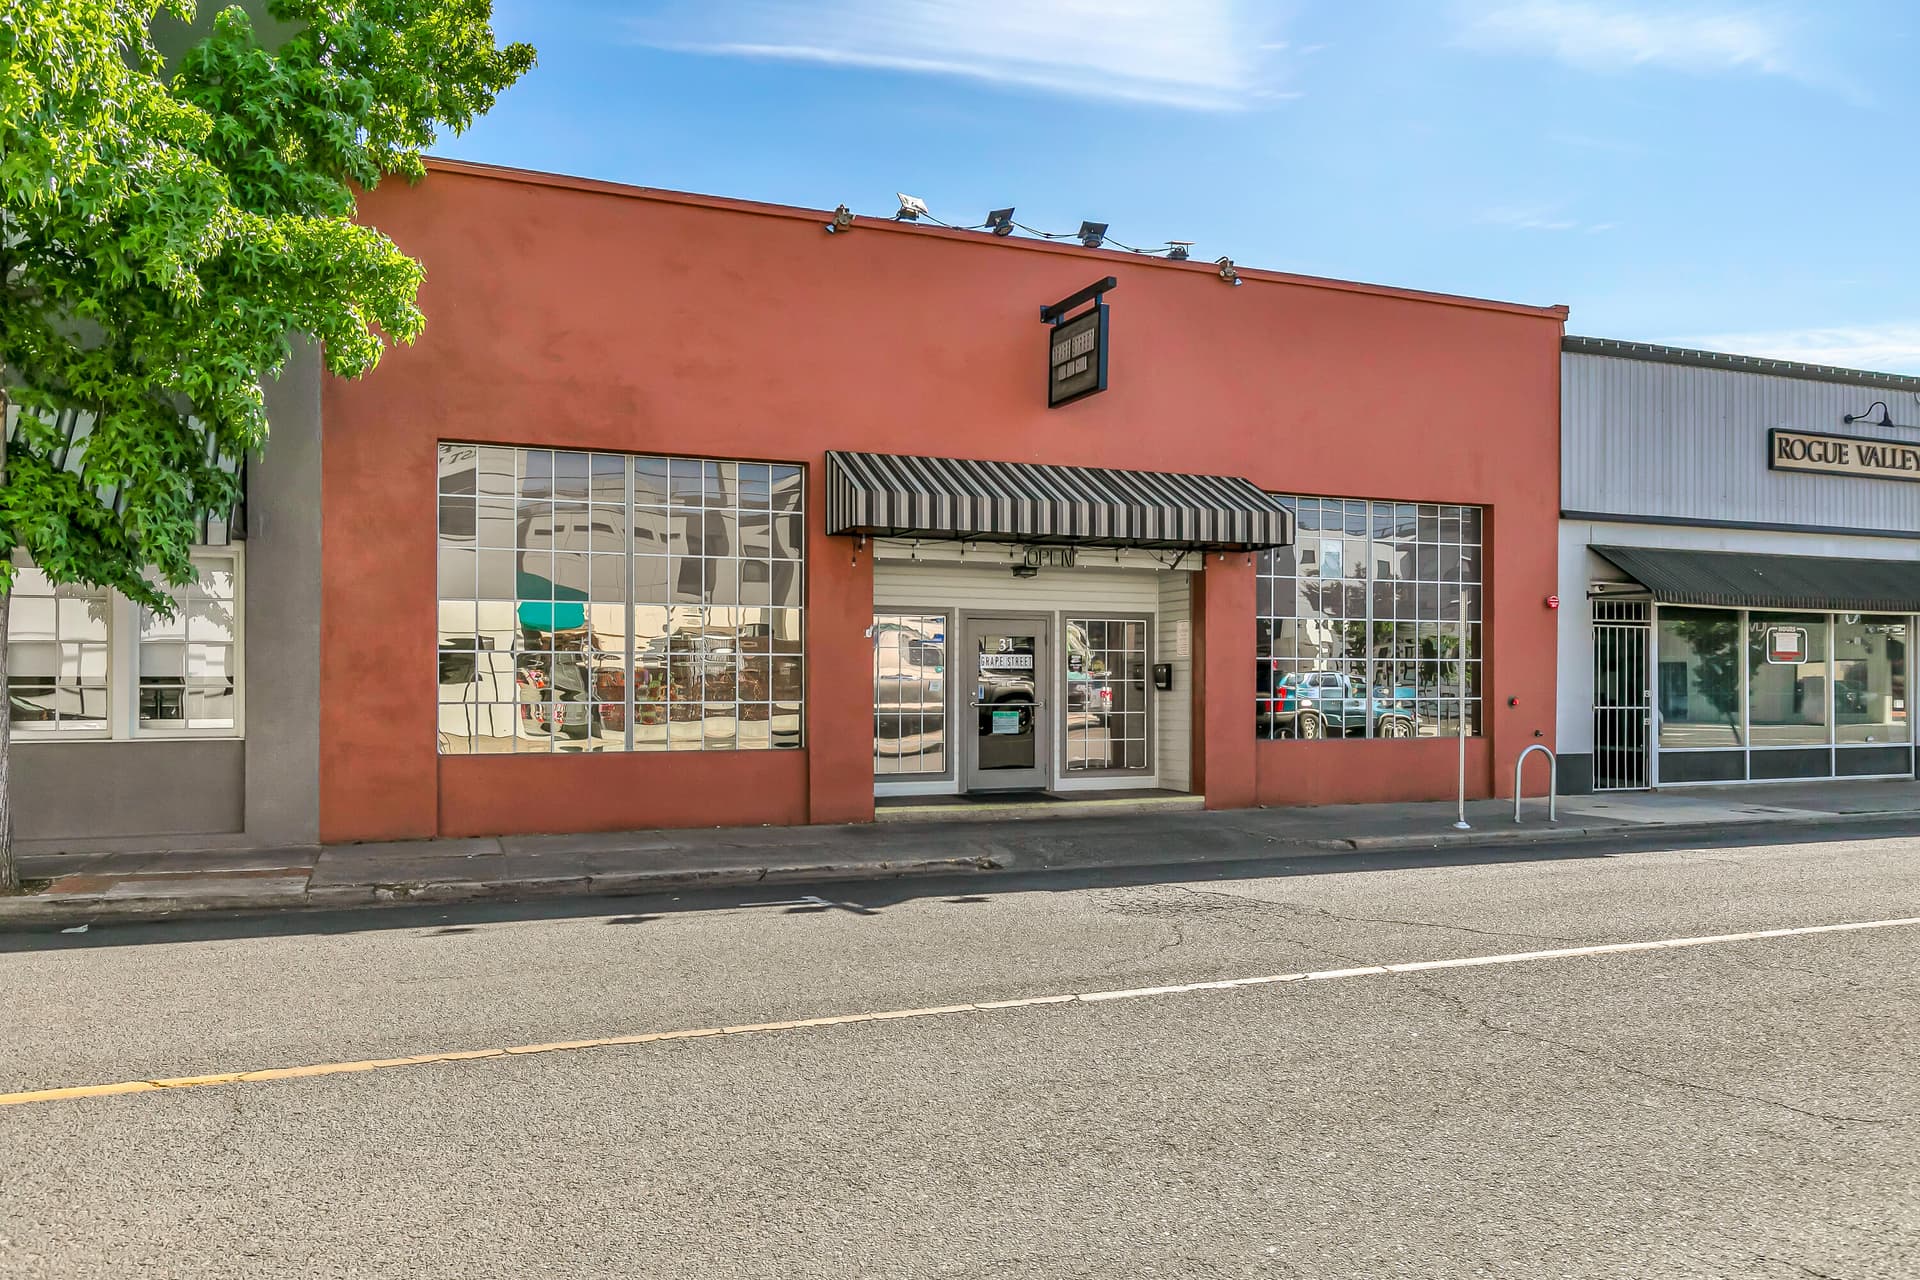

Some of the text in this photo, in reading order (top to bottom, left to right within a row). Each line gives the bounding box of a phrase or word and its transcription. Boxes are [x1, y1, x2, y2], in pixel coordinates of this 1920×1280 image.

[1777, 437, 1920, 471] ROGUE VALLEY
[999, 638, 1014, 651] 31
[980, 656, 1031, 667] GRAPE STREET
